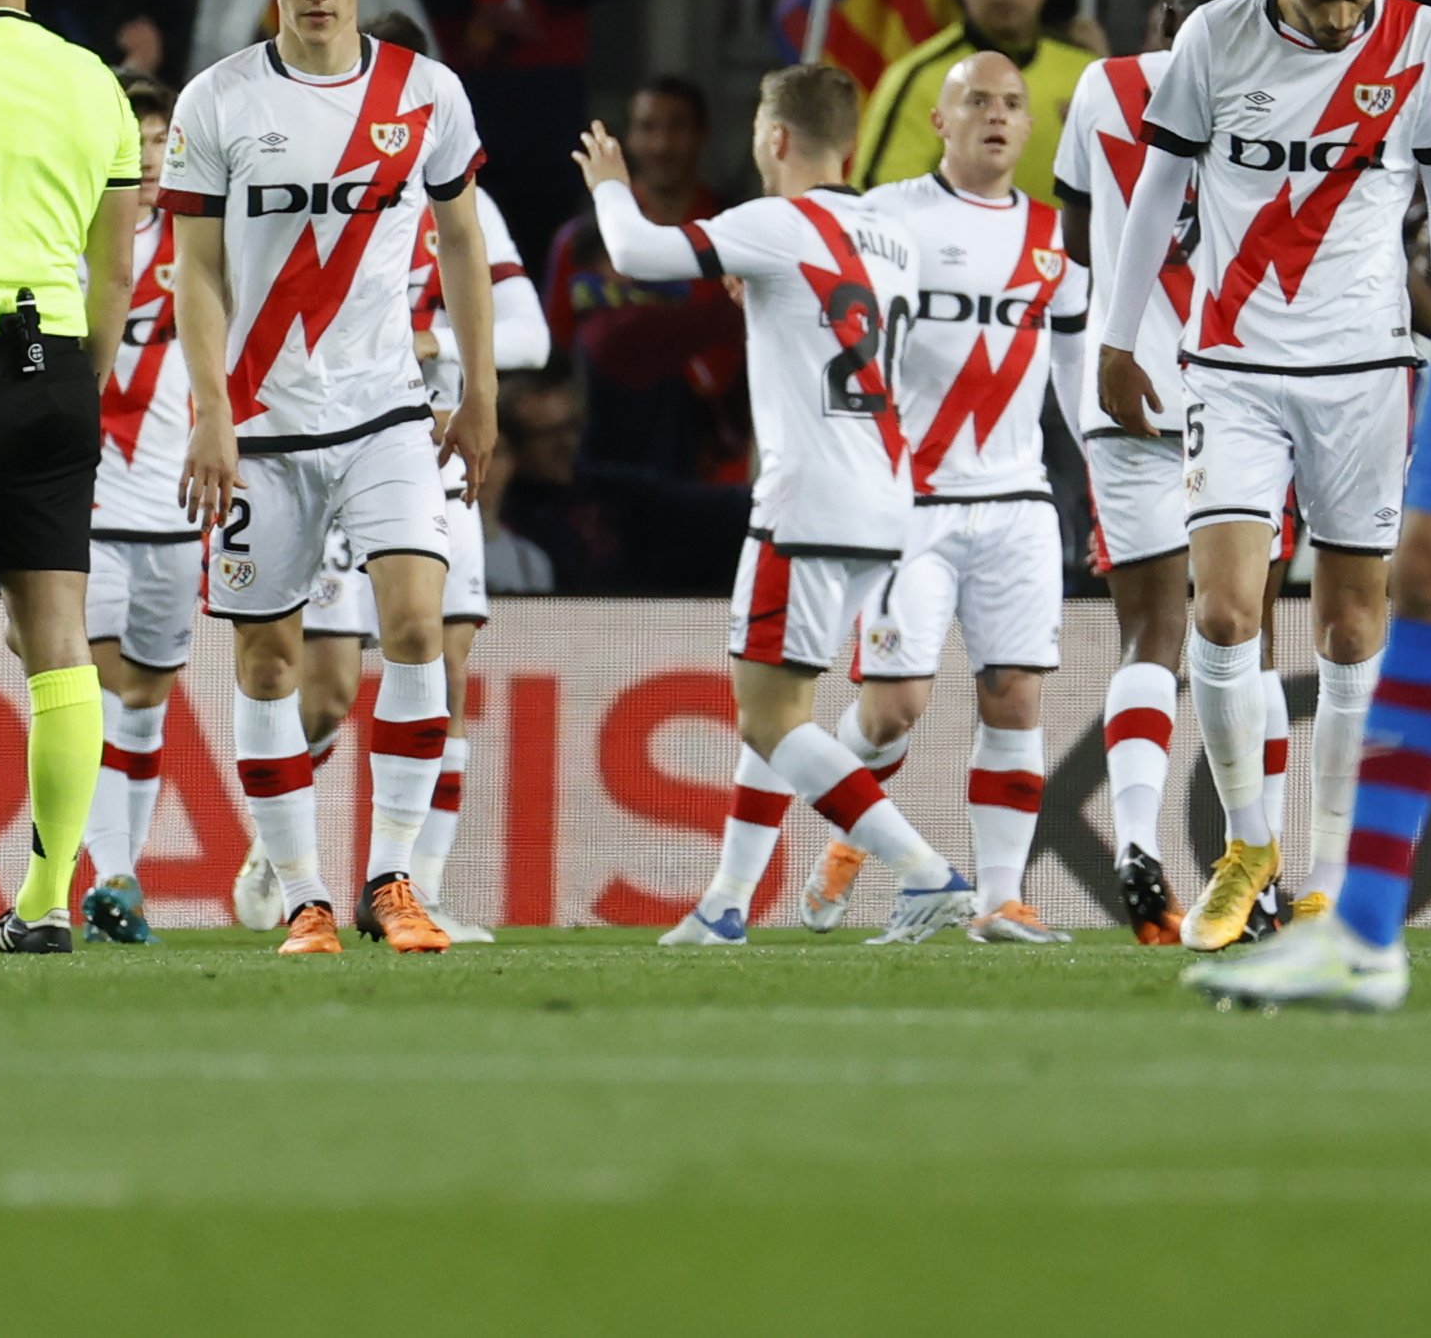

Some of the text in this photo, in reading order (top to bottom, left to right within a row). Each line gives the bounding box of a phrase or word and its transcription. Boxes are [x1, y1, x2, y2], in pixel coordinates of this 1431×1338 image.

[1228, 134, 1387, 173] DIGI
[247, 181, 408, 218] DIGI
[918, 290, 1046, 331] DIG
